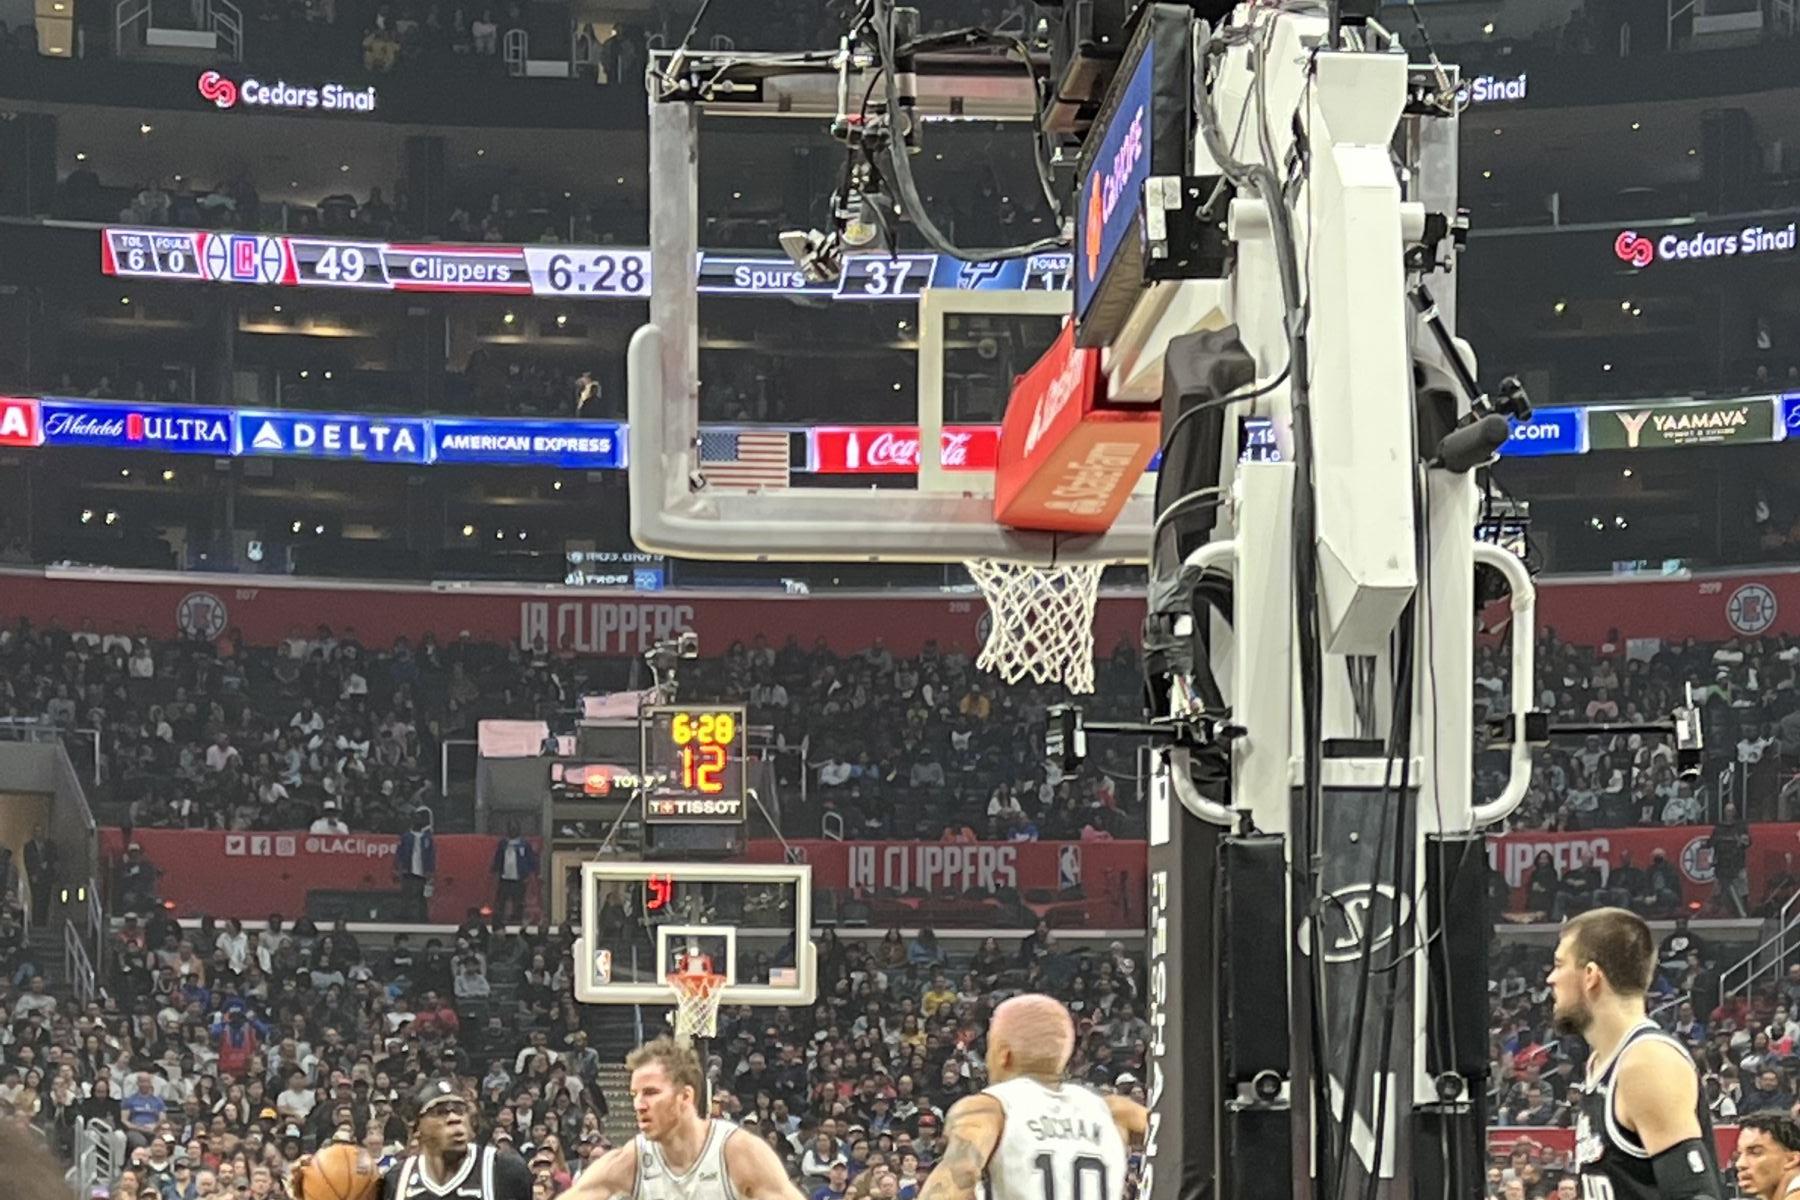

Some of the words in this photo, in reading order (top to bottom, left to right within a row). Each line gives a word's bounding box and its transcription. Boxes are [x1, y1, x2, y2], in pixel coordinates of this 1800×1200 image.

[241, 79, 318, 107] Cedars
[322, 84, 375, 110] Sinai
[1472, 74, 1526, 101] Sinai
[1659, 232, 1738, 260] Cedars
[1741, 223, 1796, 252] Sinai
[128, 250, 145, 272] 6
[168, 252, 185, 273] 0
[315, 247, 364, 282] 49
[409, 257, 512, 284] Clippers
[549, 254, 645, 292] 6:28
[734, 265, 806, 291] Spurs
[864, 261, 913, 294] 37
[1042, 271, 1053, 292] 1
[45, 408, 124, 437] Michelob
[144, 412, 227, 442] ULTRA
[294, 423, 416, 453] DELTA
[441, 434, 530, 452] AMERICAN
[534, 436, 612, 454] EXPRESS
[672, 712, 735, 745] 6:28
[682, 744, 727, 793] 12
[676, 800, 740, 814] TISSOT
